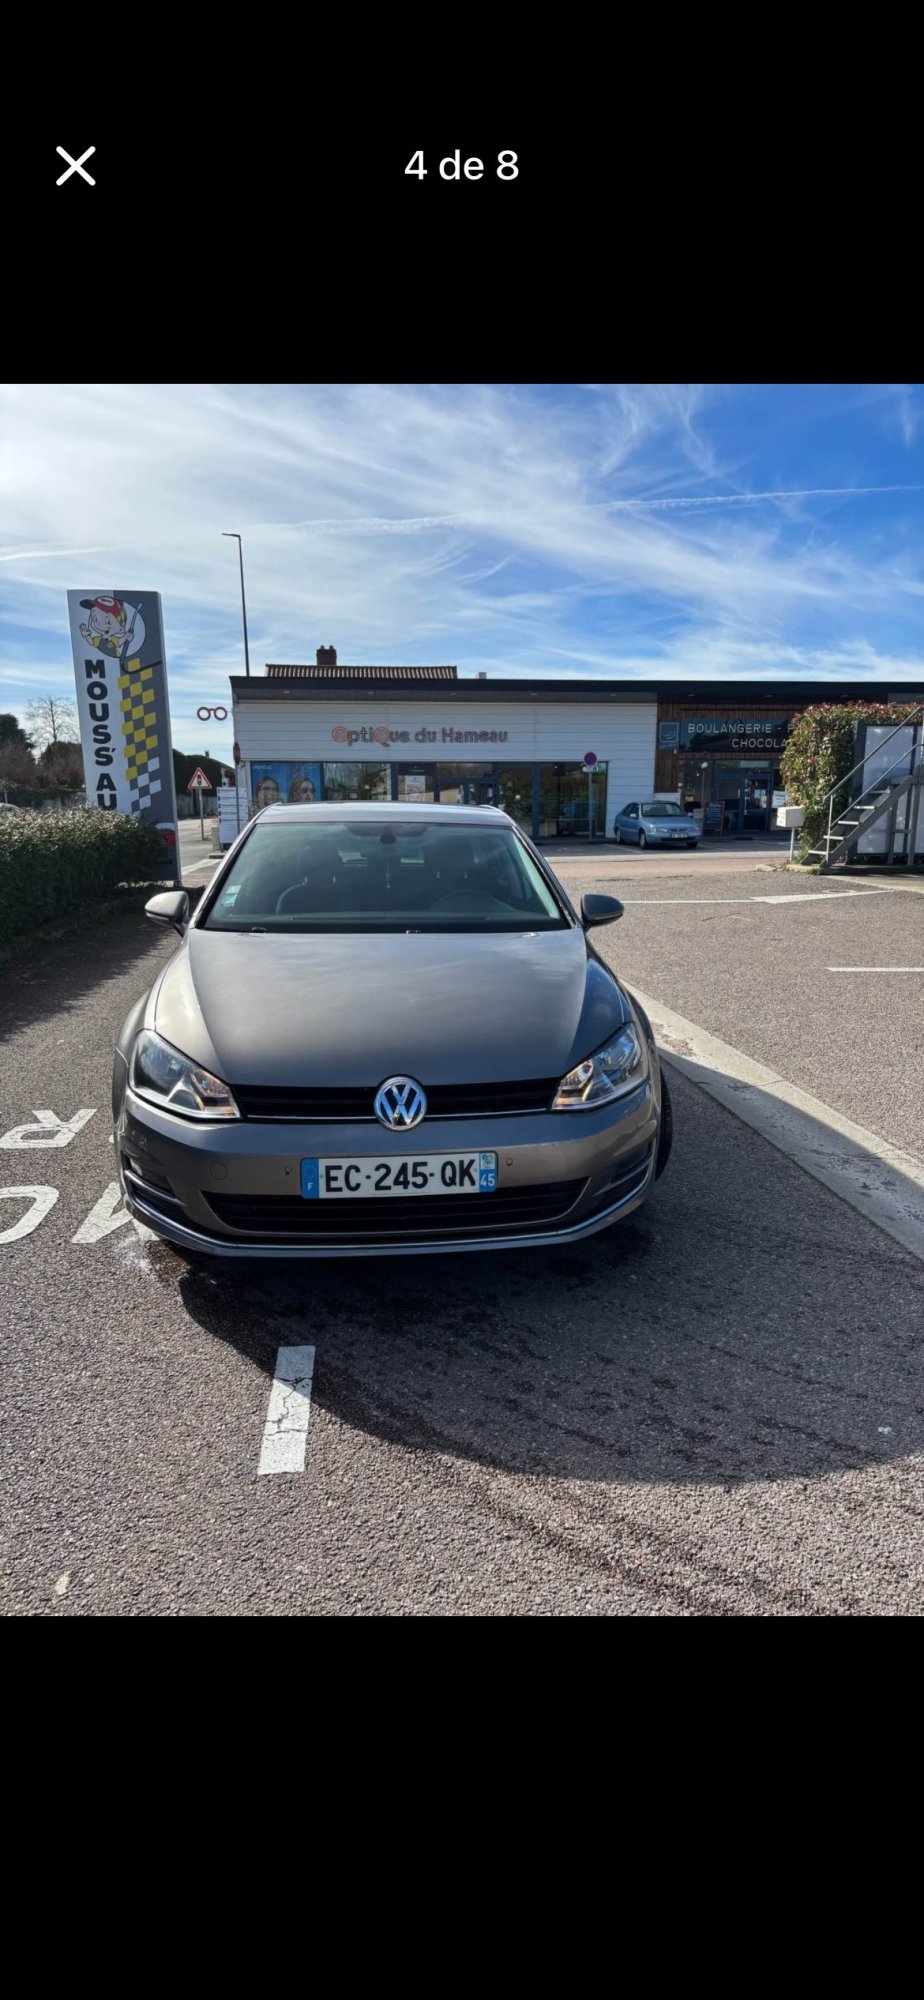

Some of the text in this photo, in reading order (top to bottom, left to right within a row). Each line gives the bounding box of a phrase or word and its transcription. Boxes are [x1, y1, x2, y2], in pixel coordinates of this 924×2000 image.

[84, 659, 117, 811] MOUSS'AU
[415, 727, 436, 743] du
[442, 727, 508, 743] Hameau
[687, 723, 772, 733] BOULANGERIE
[731, 738, 787, 748] CHOCOLA
[307, 1182, 313, 1191] F
[480, 1173, 495, 1187] 45
